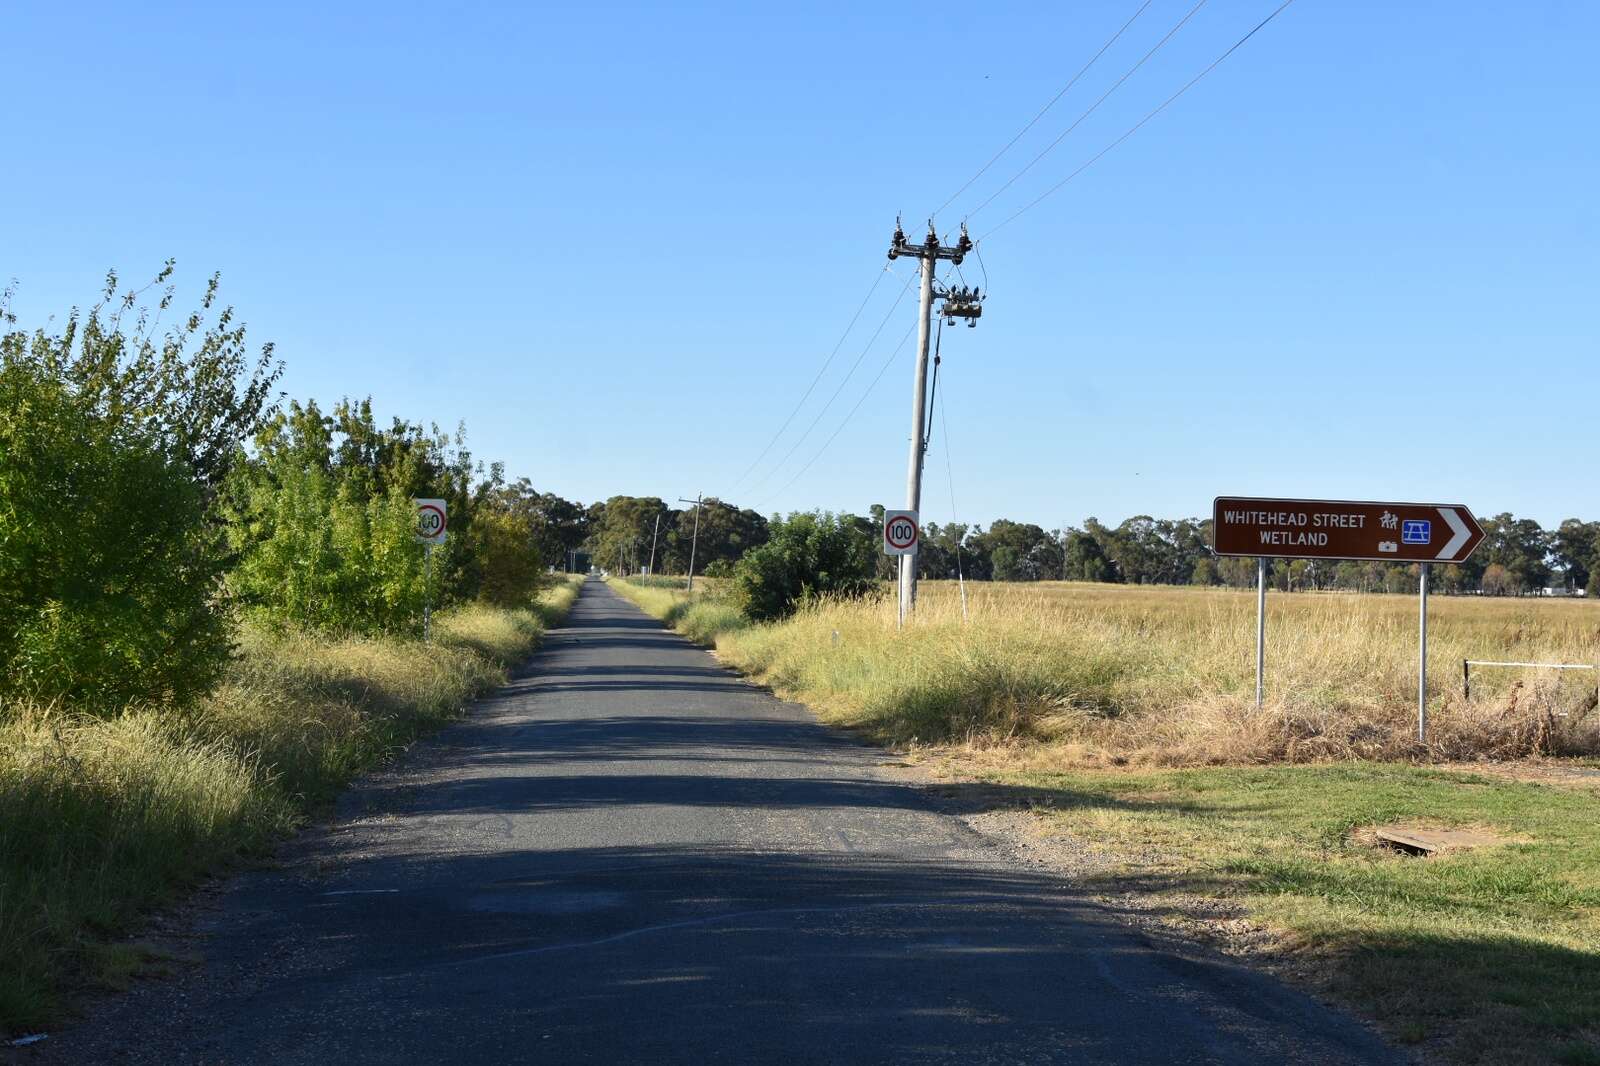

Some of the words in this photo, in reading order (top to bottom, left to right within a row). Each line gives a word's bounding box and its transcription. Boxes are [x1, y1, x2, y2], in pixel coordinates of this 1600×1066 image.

[1224, 510, 1307, 526] WHITEHEAD
[1313, 513, 1366, 528] STREET
[891, 525, 912, 540] 100
[1260, 530, 1328, 546] WETLAND
